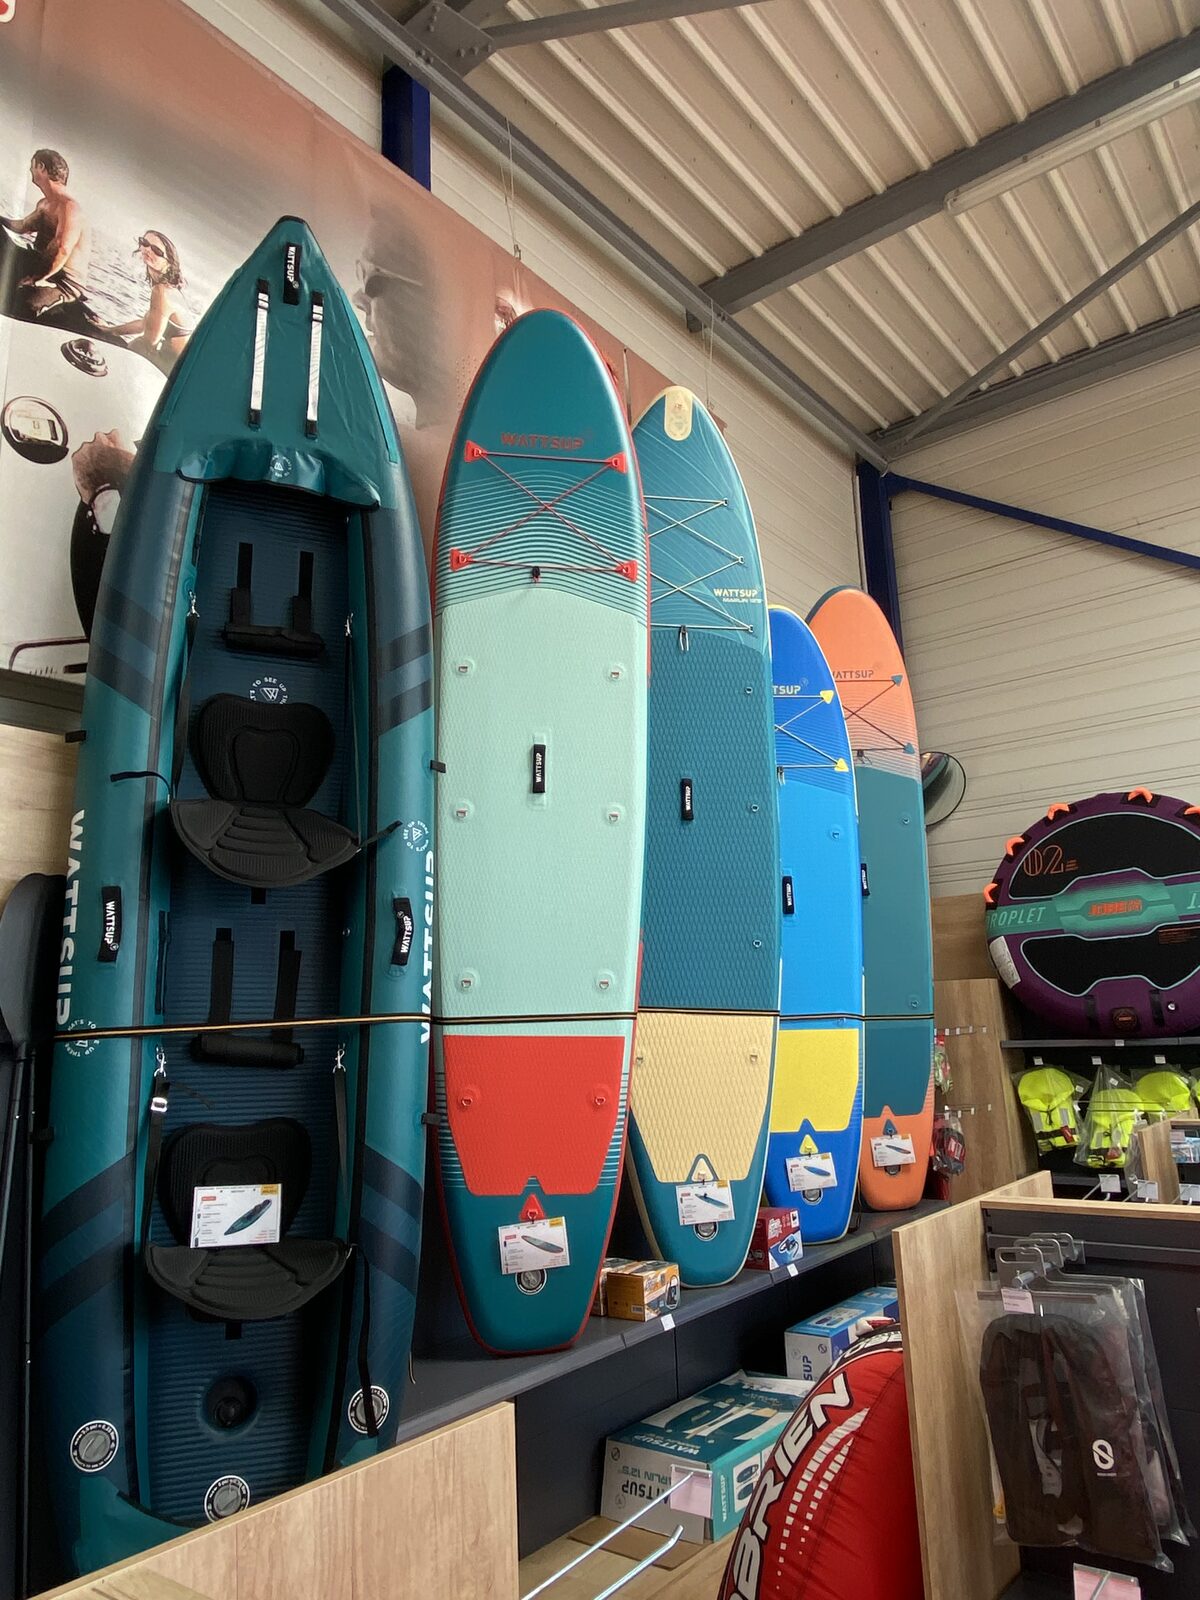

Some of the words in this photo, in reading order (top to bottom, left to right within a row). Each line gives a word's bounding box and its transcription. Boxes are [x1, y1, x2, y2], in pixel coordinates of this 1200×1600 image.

[286, 246, 296, 282] WATTSUP
[501, 432, 585, 450] WATTSUP
[713, 588, 758, 598] WATTSUP
[832, 670, 875, 679] ATTSUP
[773, 685, 801, 695] TSUP
[104, 900, 116, 944] WATTSUP
[401, 915, 412, 953] WATTSUP
[729, 1373, 851, 1600] BRIEN
